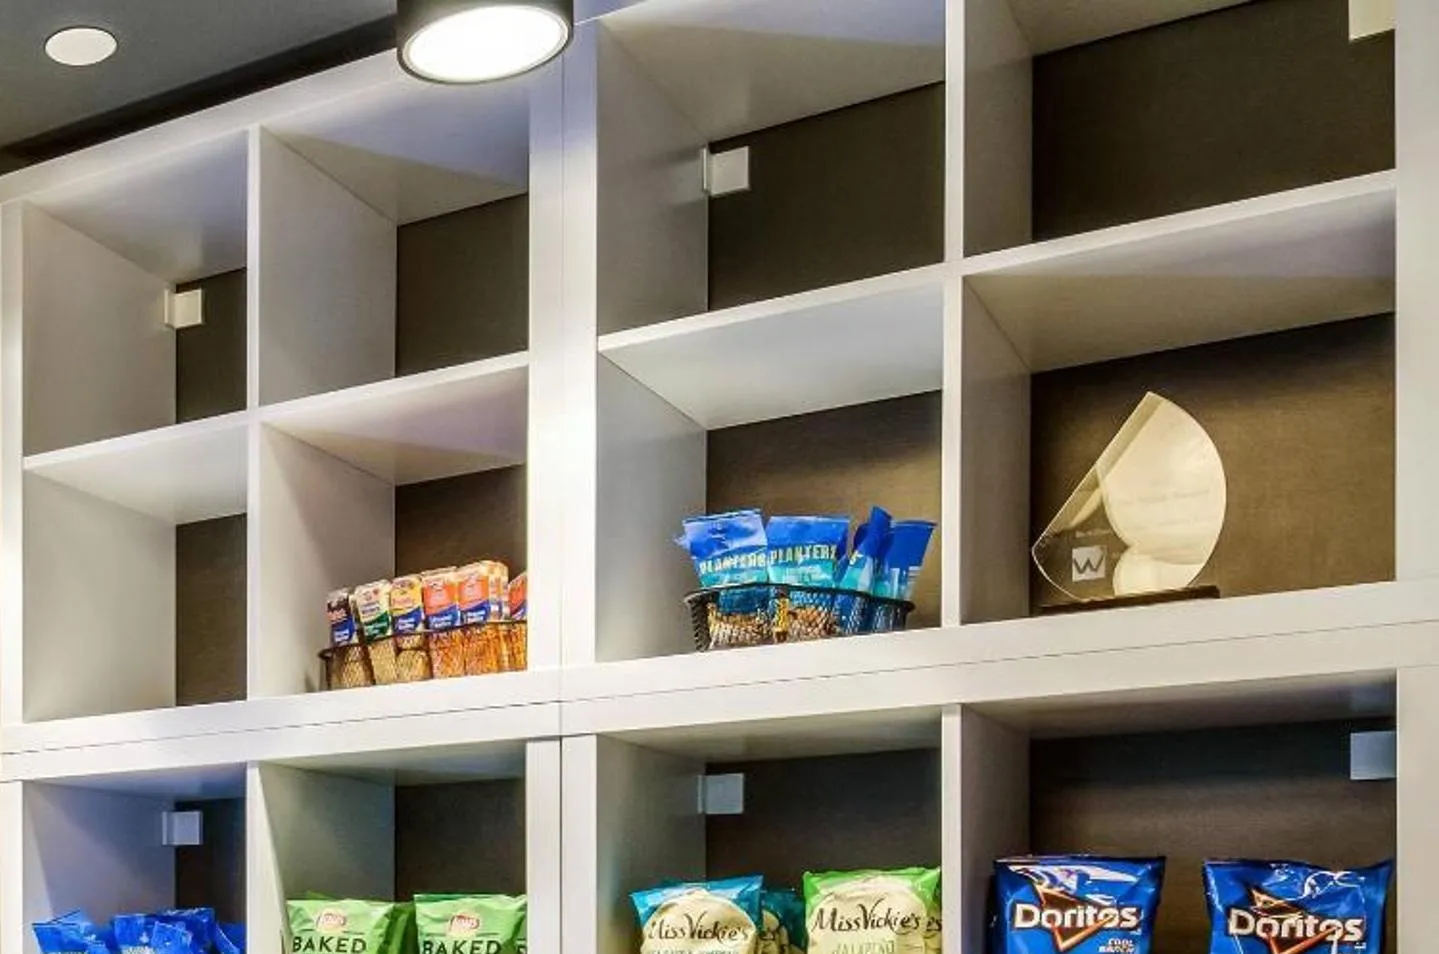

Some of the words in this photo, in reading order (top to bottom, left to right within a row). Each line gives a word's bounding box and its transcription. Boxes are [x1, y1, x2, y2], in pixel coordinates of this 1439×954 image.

[812, 907, 861, 933] Miss
[858, 898, 921, 936] Vickie's
[1013, 902, 1139, 930] Doritos
[1228, 907, 1364, 942] Doritos
[292, 935, 367, 954] BAKED
